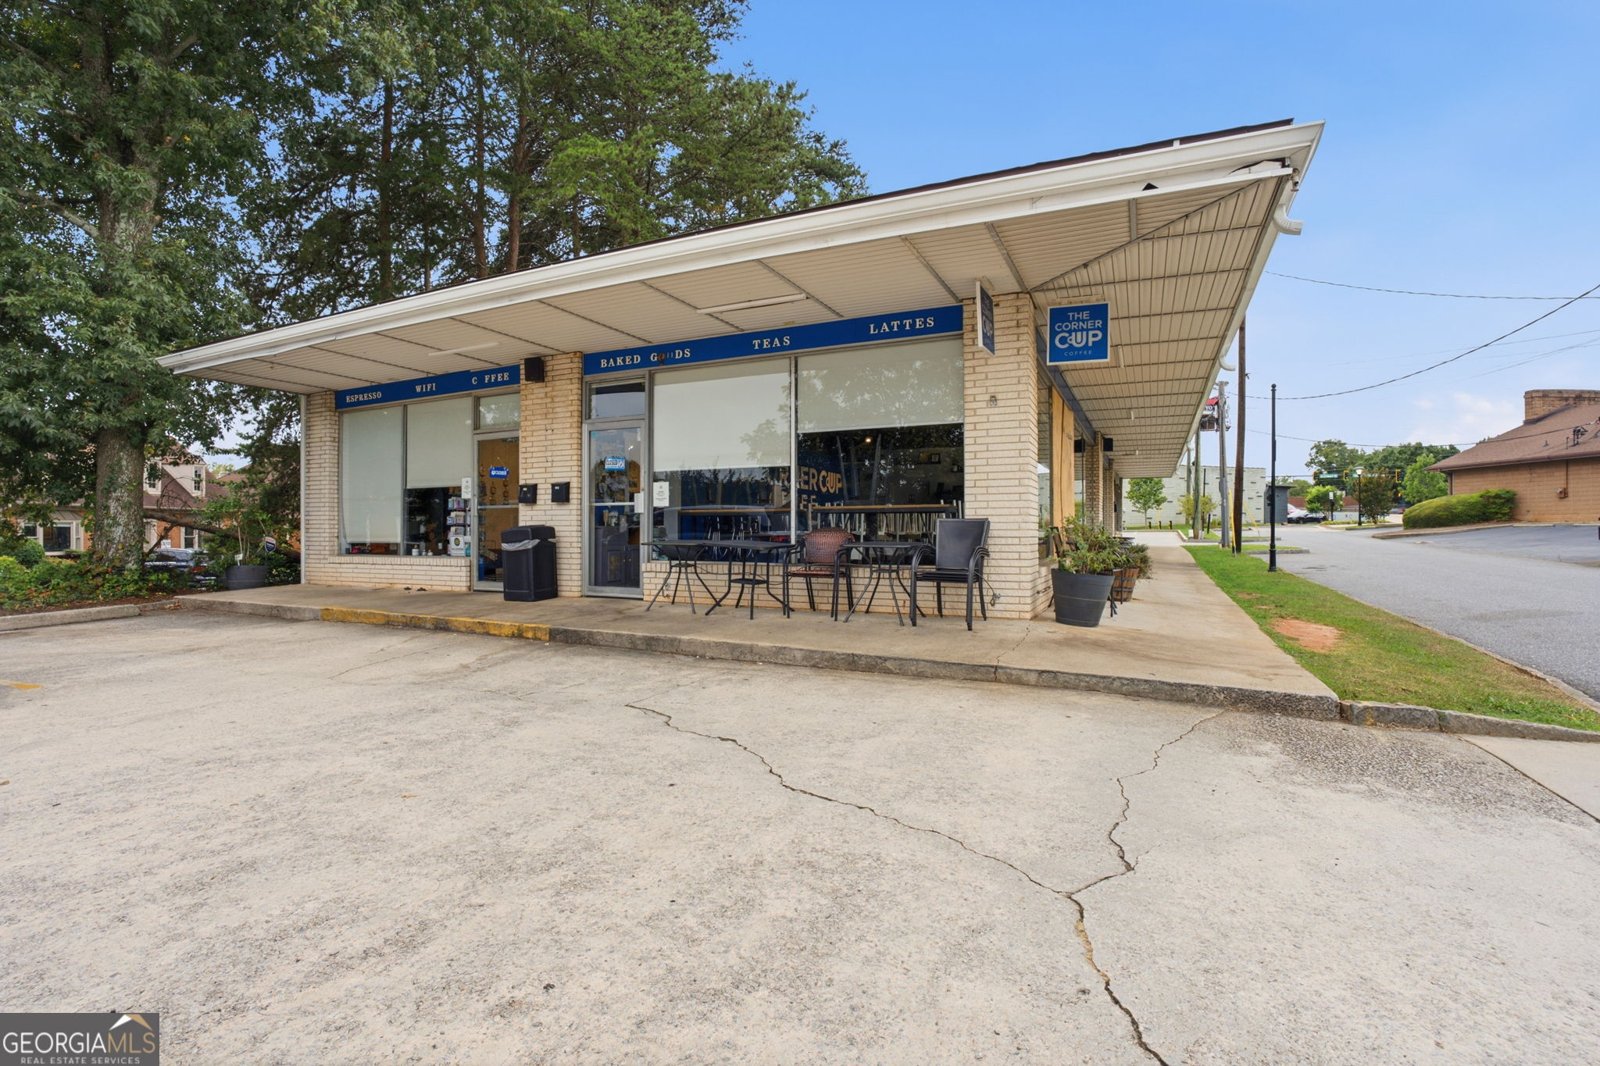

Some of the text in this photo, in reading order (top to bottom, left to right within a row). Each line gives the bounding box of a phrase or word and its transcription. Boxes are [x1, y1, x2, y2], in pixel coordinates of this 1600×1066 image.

[1067, 311, 1090, 321] THE
[869, 316, 935, 335] LATTES
[1054, 319, 1103, 332] CORNER
[752, 336, 791, 350] TEAS
[1054, 330, 1103, 349] CUP
[600, 354, 641, 368] BAKED
[415, 382, 437, 393] WIFI
[346, 391, 382, 403] ESPRESSO
[819, 470, 843, 494] CUP
